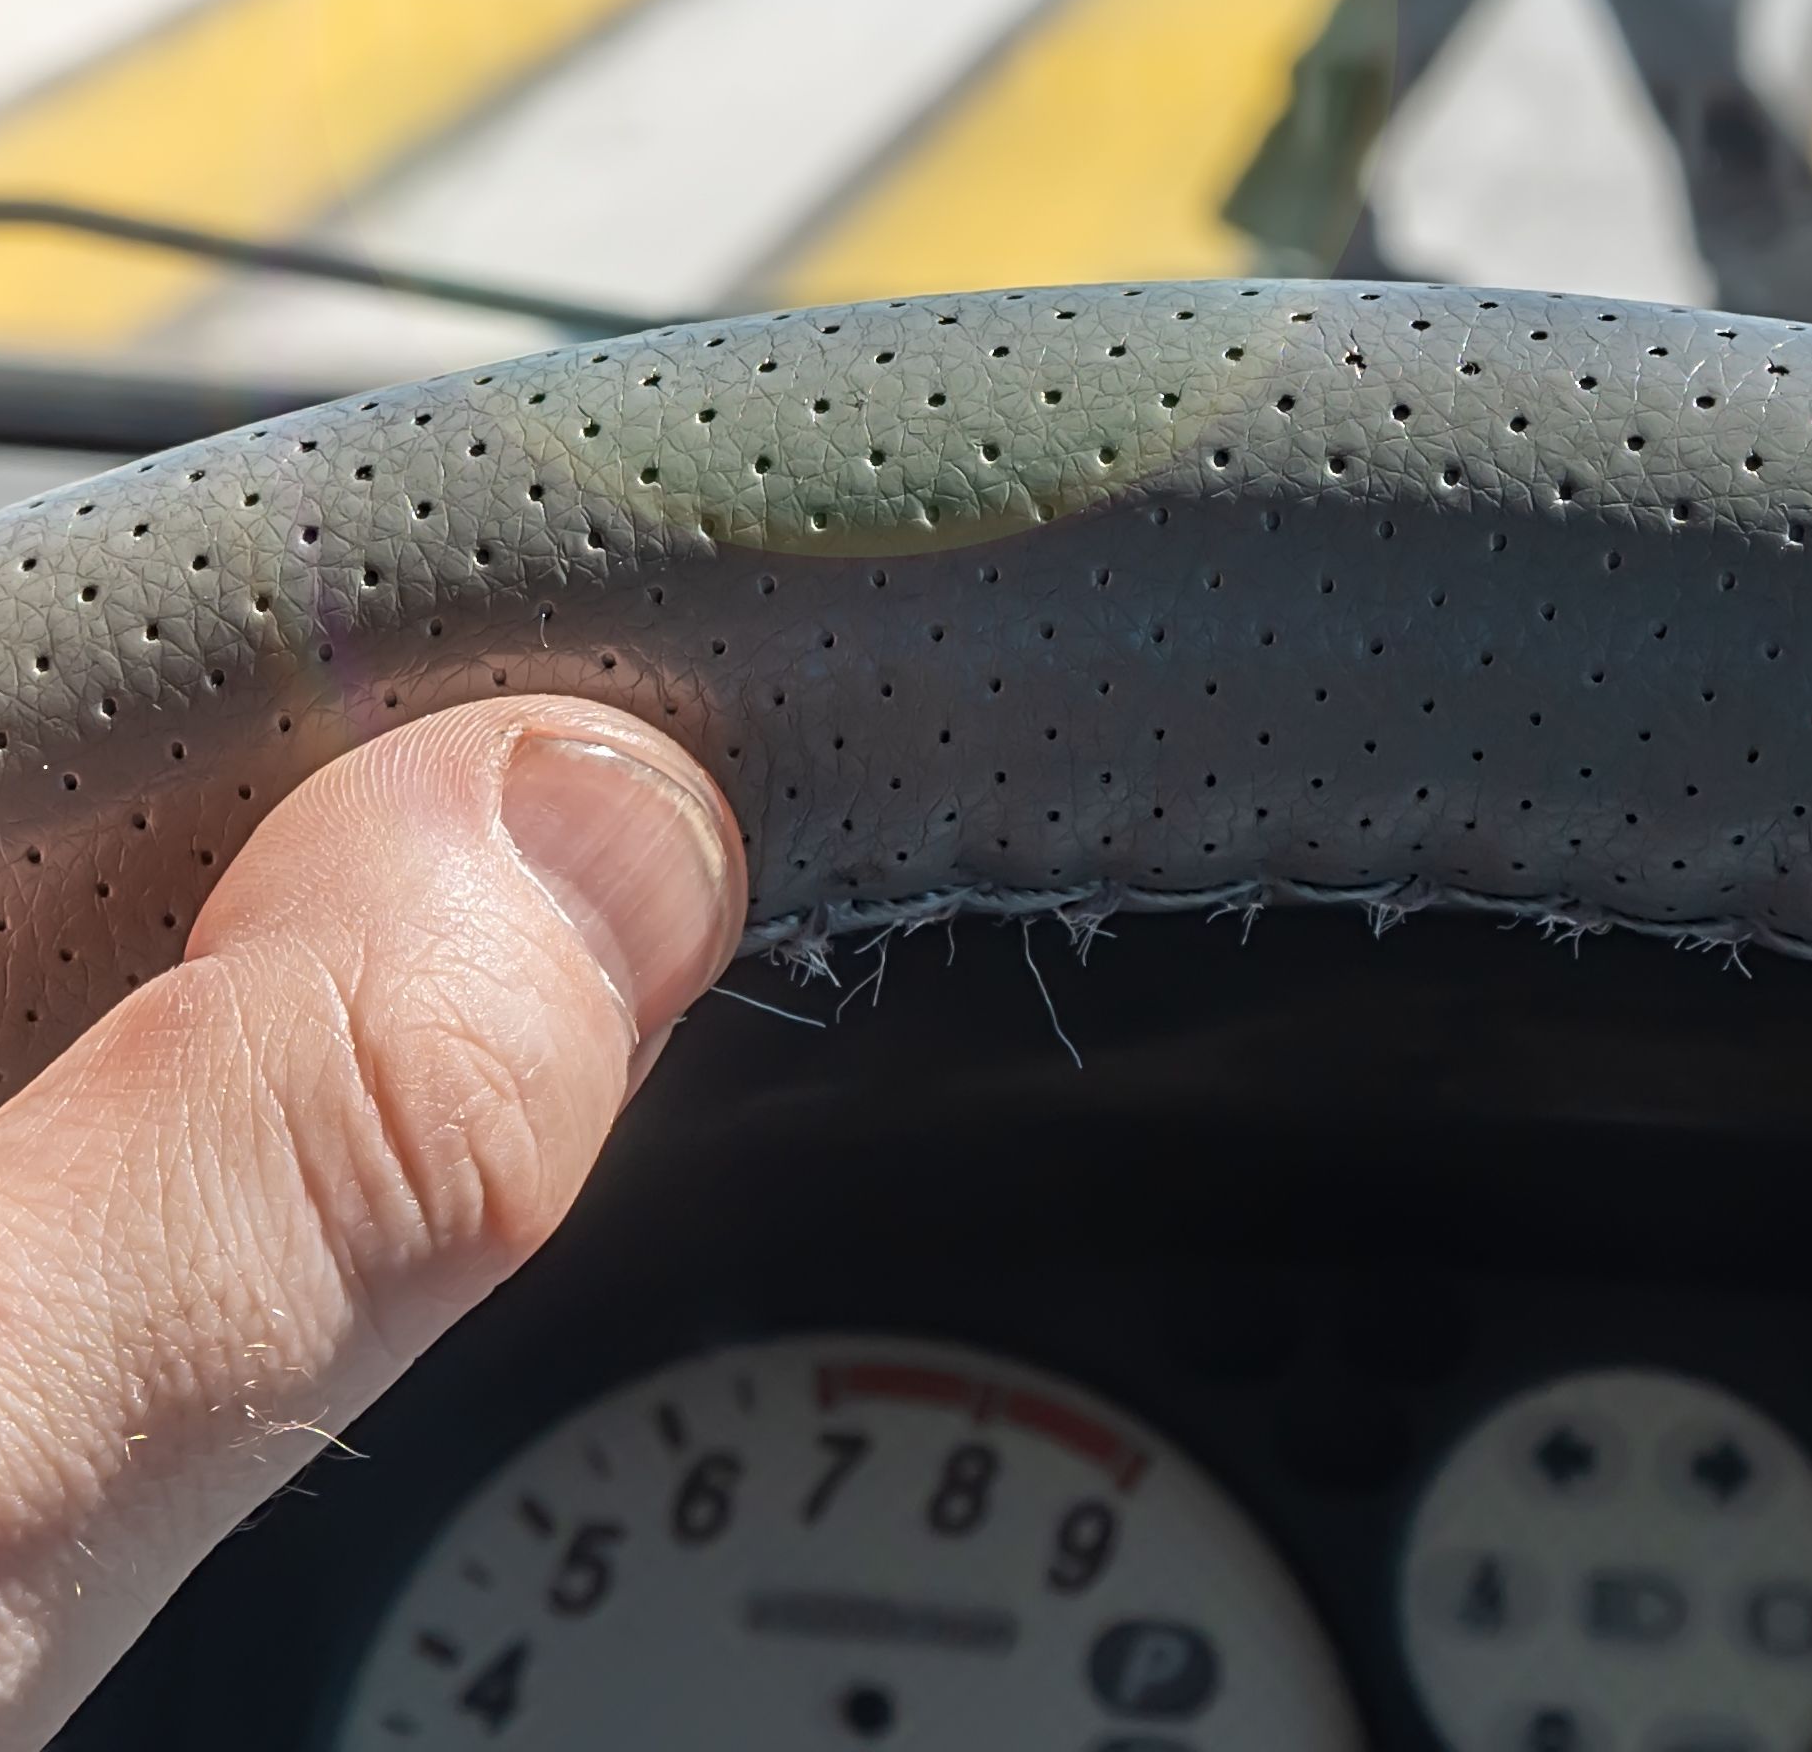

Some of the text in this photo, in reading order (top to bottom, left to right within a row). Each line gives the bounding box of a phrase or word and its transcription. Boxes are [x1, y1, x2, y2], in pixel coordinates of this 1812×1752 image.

[671, 1452, 743, 1545] 6
[799, 1431, 871, 1526] 7
[923, 1446, 995, 1536] 8
[549, 1522, 625, 1617] 5
[1048, 1499, 1116, 1593] 9
[460, 1642, 532, 1733] 4
[1121, 1632, 1188, 1701] P
